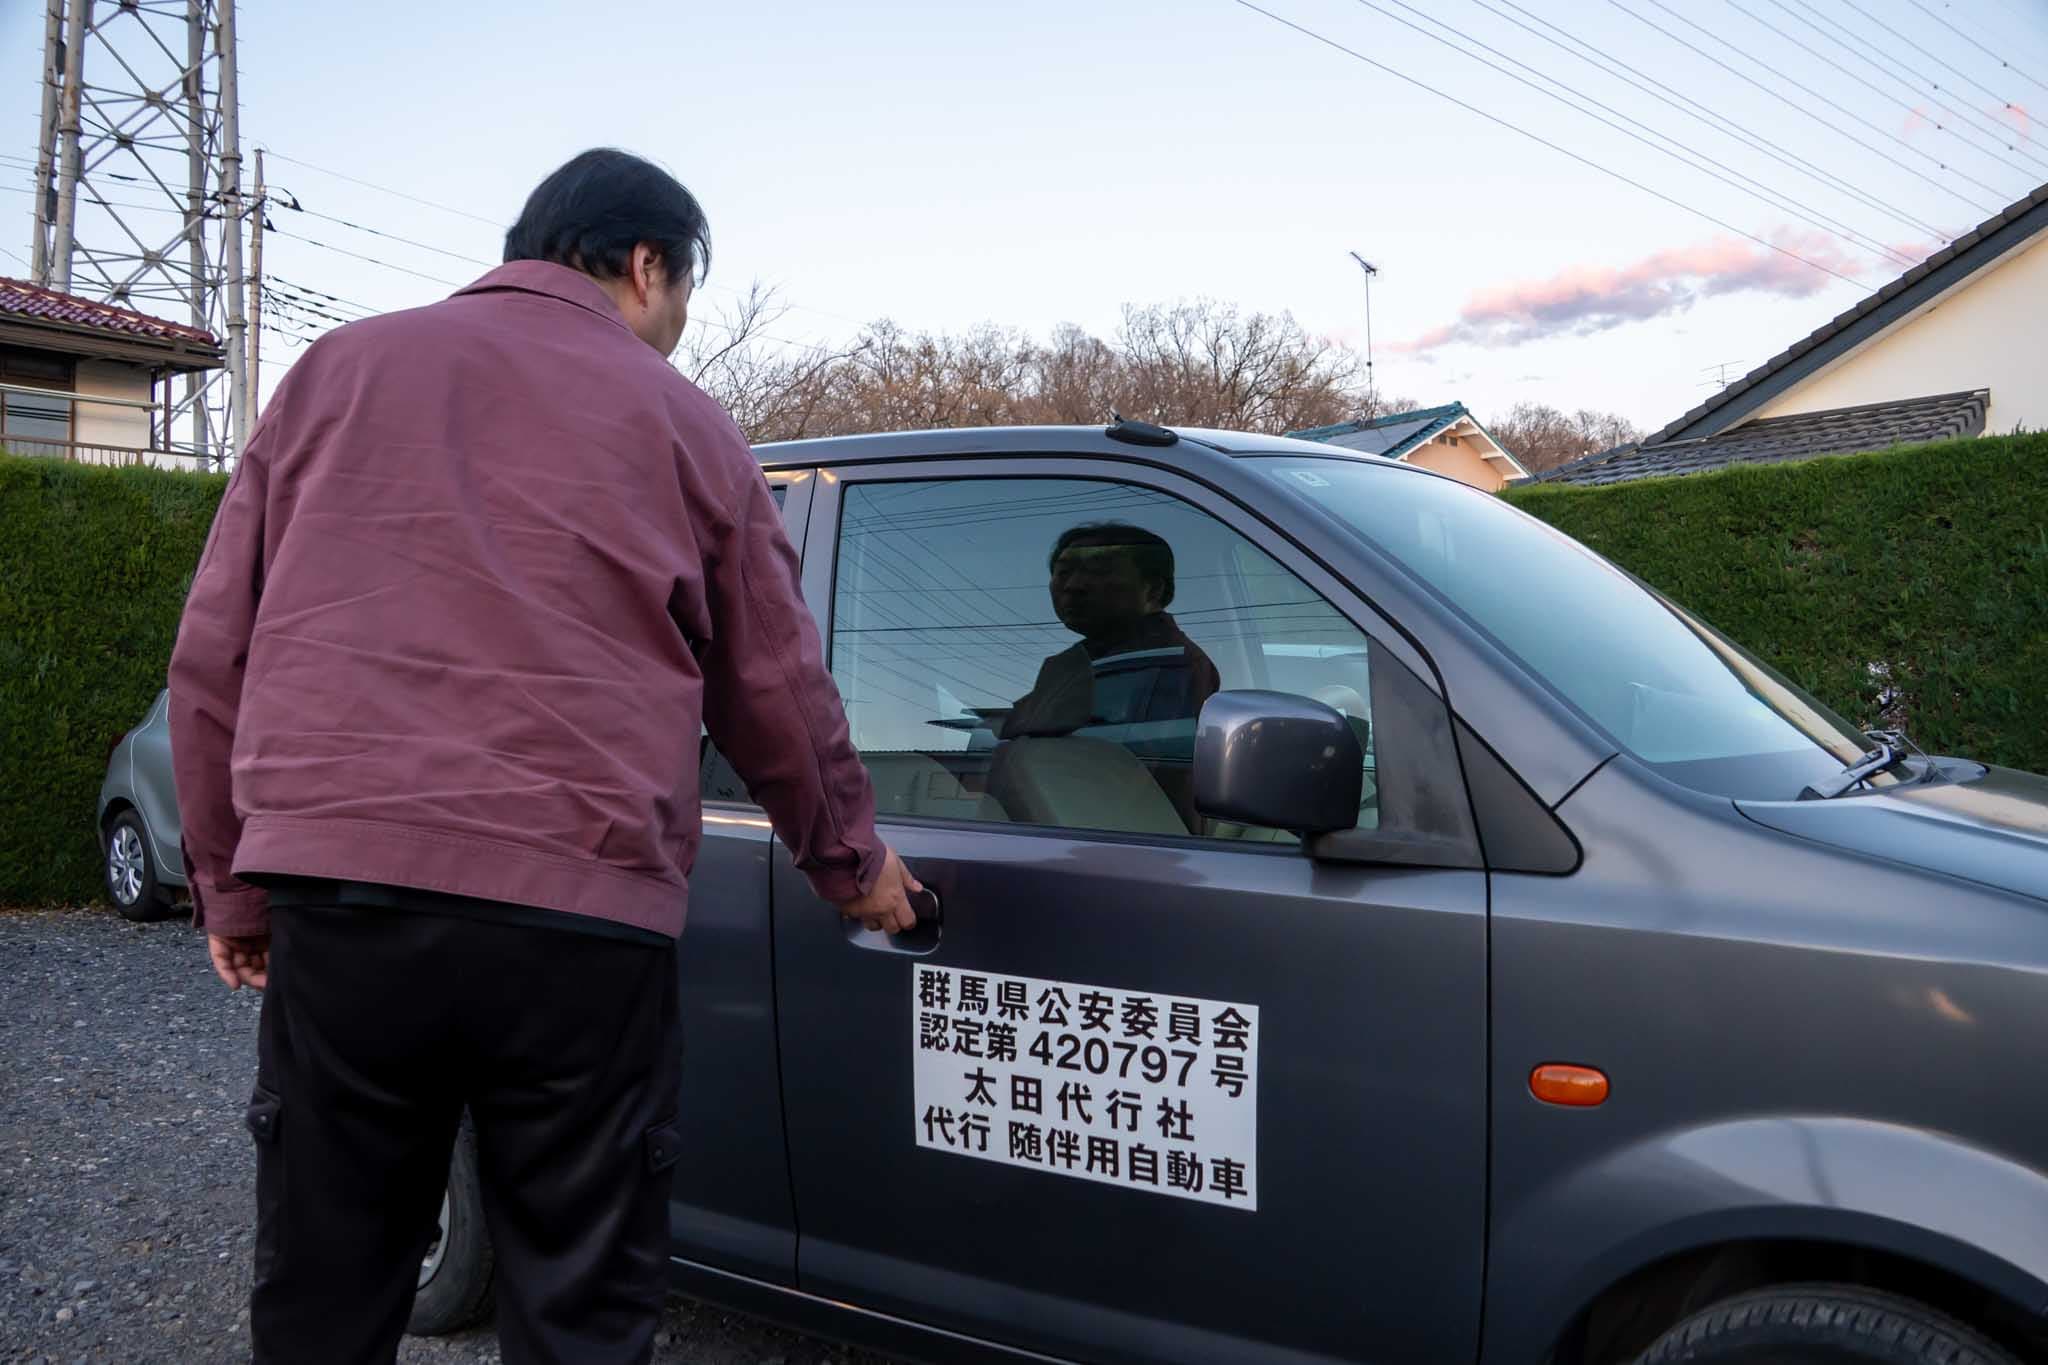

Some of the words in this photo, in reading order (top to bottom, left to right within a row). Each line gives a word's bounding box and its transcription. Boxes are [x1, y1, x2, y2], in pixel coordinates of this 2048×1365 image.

[918, 969, 1251, 1052] 群馬県公安委員会
[963, 1066, 1195, 1141] 太田代行社
